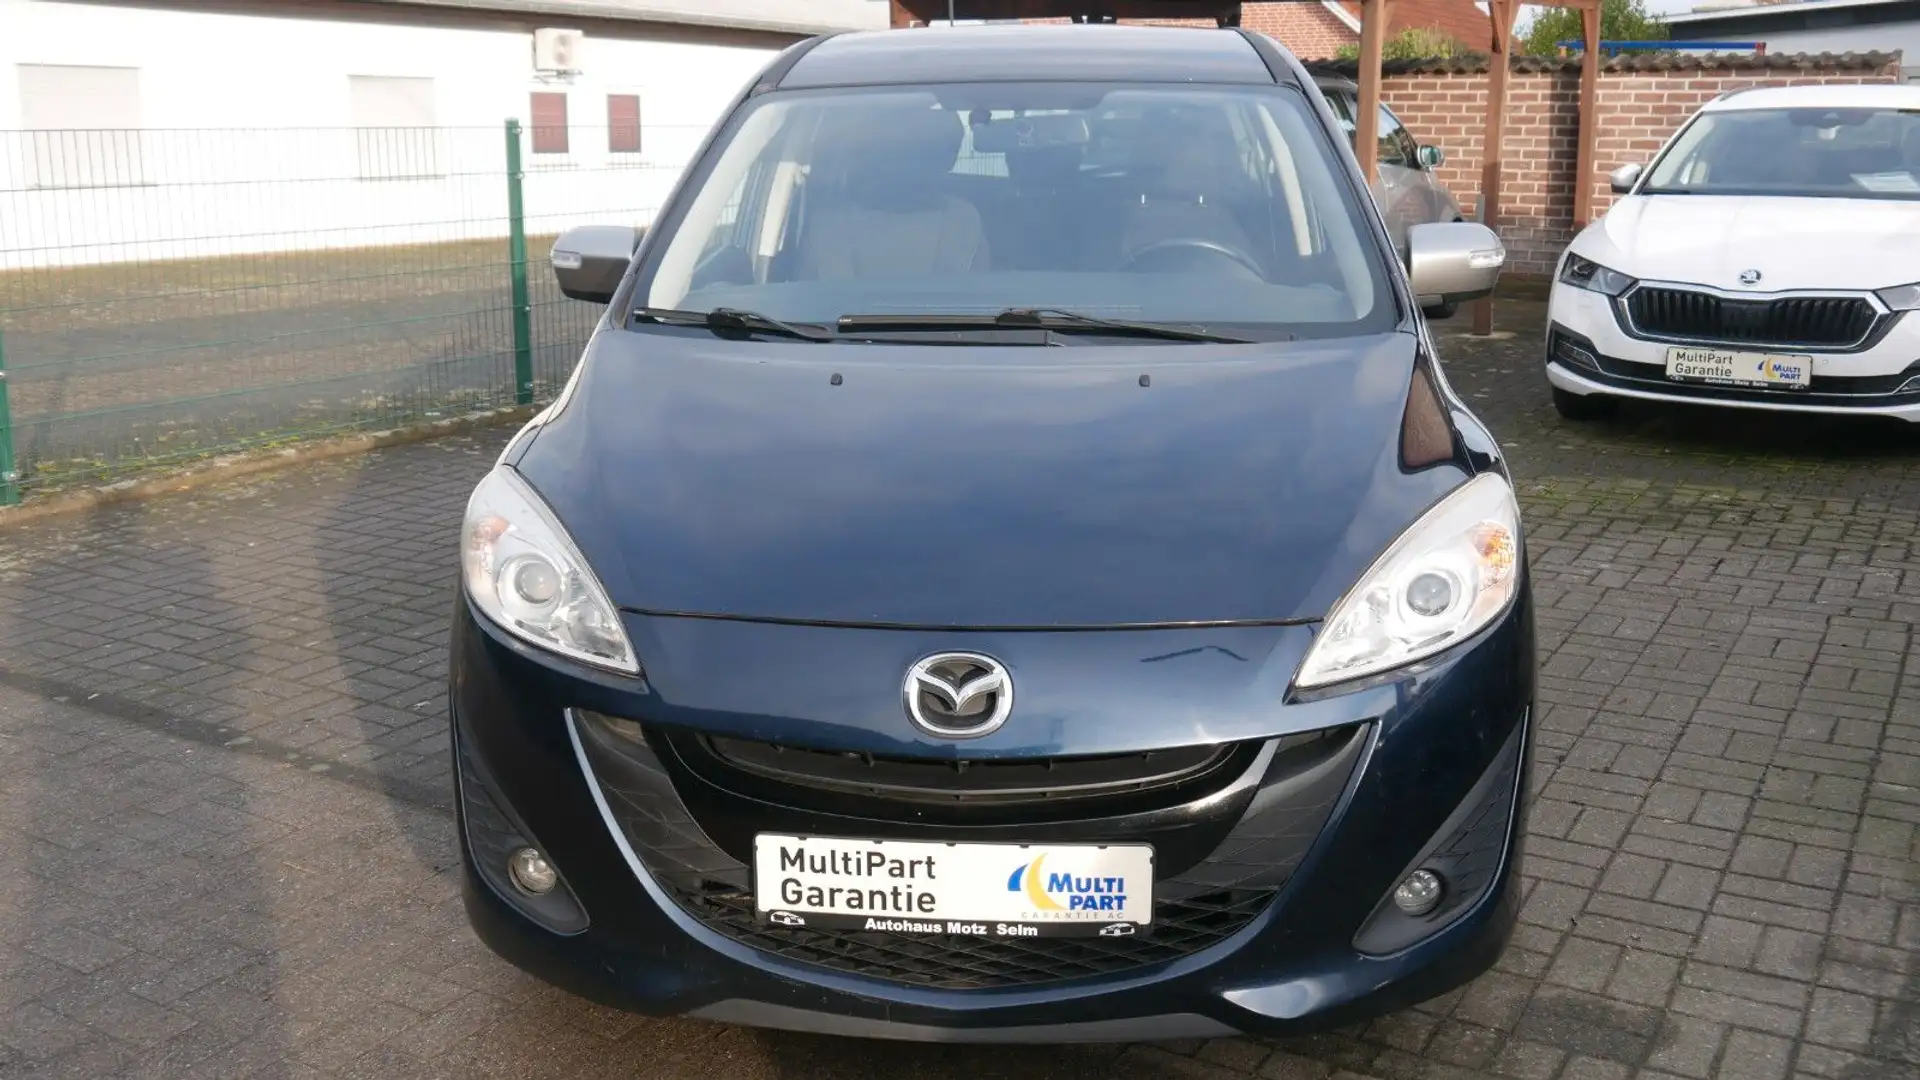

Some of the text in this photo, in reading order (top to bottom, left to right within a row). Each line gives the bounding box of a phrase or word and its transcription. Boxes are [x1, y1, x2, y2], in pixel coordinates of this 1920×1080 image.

[1676, 350, 1733, 365] MultiPart
[1675, 362, 1732, 377] Garantie
[1772, 364, 1801, 374] MULTI
[1779, 372, 1801, 380] PART
[779, 846, 936, 880] MultiPart
[1047, 872, 1125, 893] MULTI
[780, 878, 936, 914] Garantie
[1068, 894, 1127, 911] PART
[864, 917, 1039, 937] Autohaus Motz Selm
